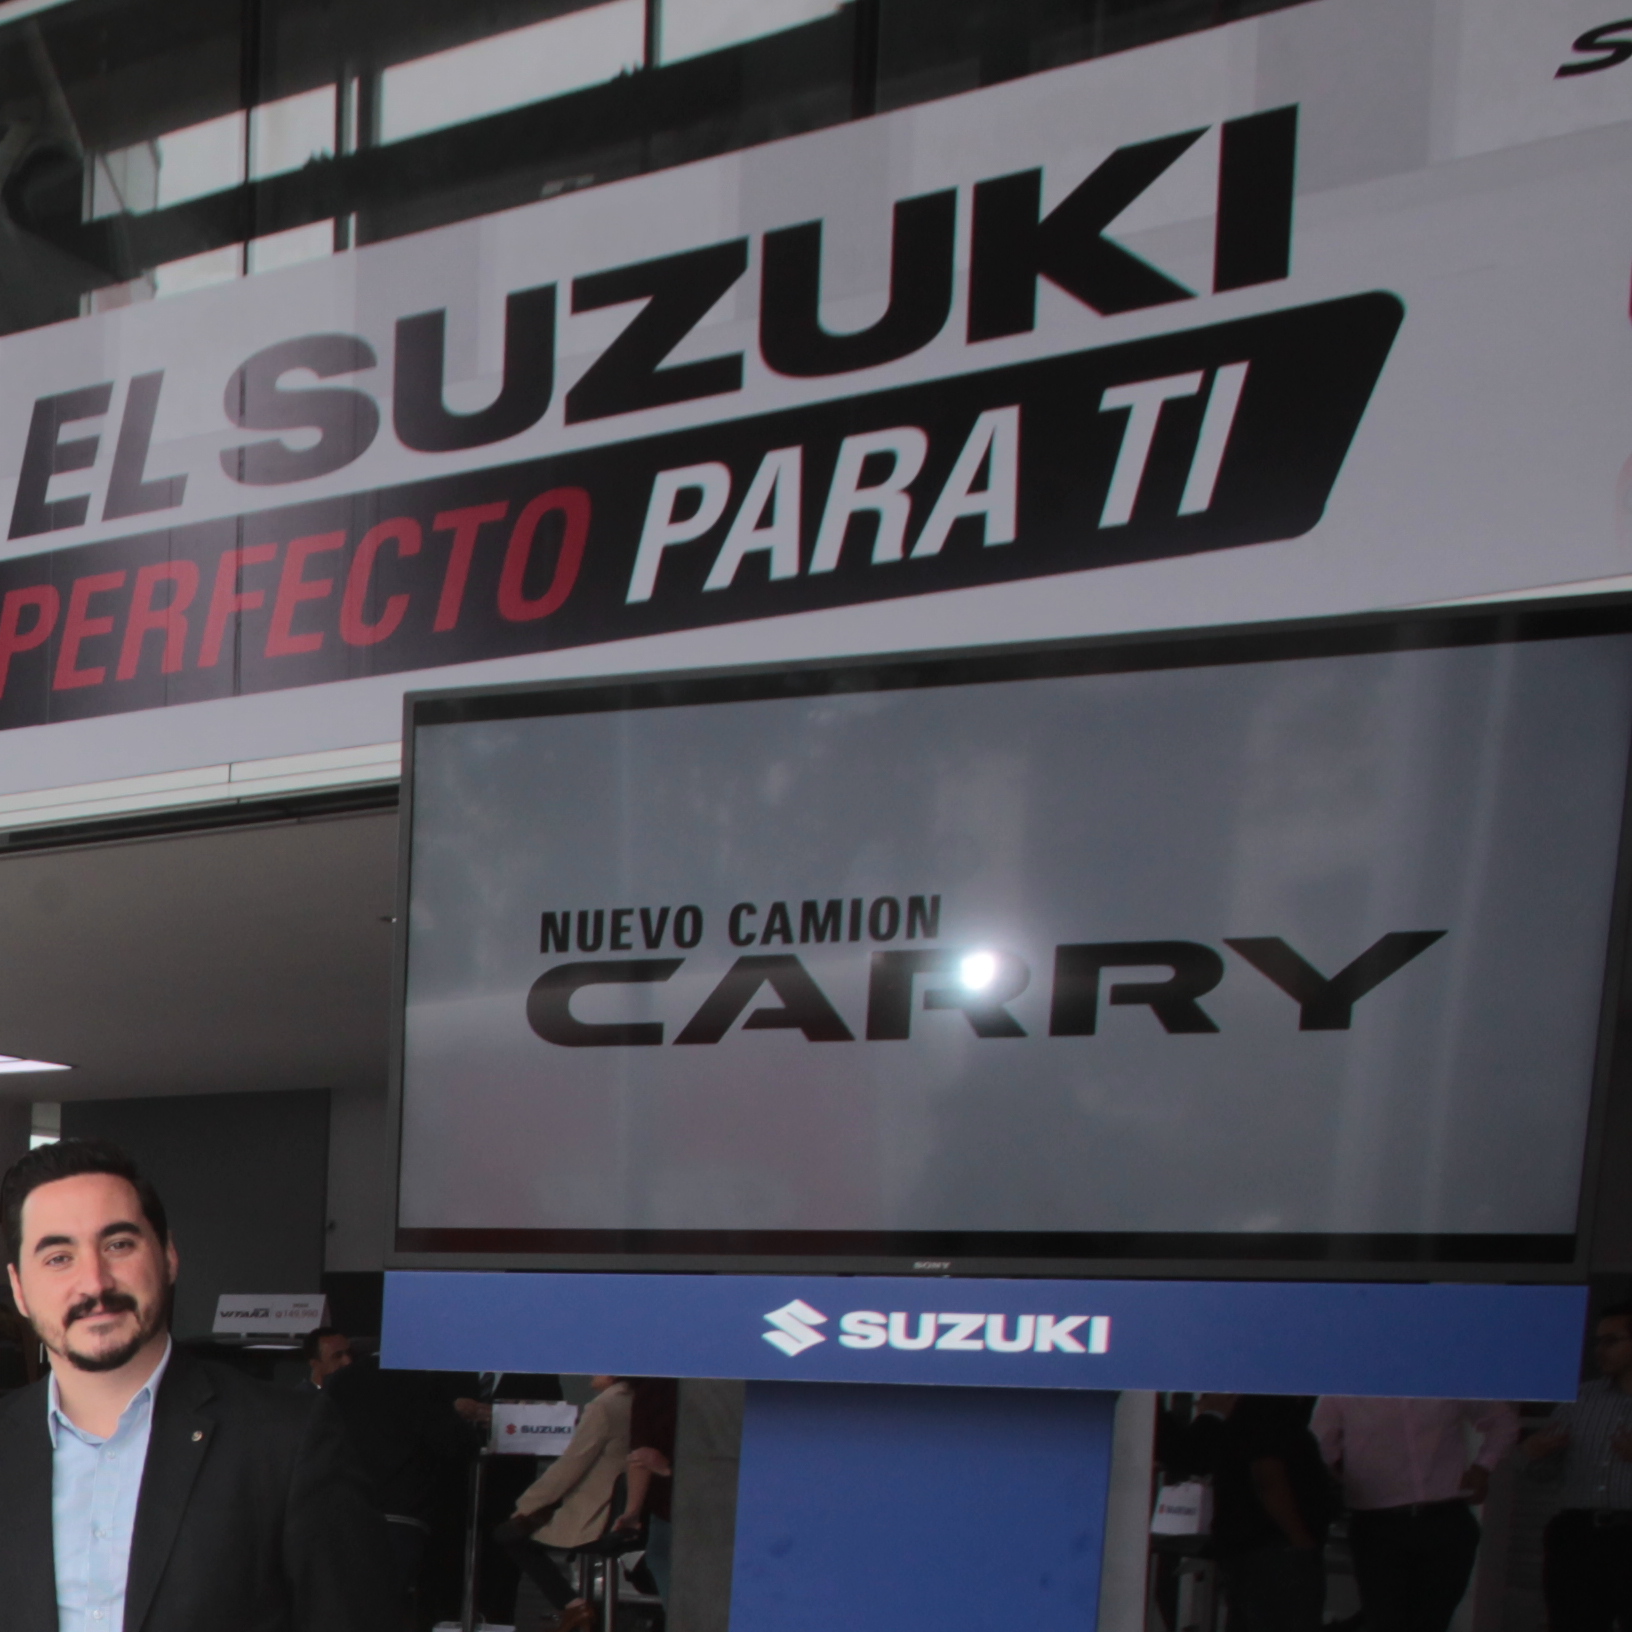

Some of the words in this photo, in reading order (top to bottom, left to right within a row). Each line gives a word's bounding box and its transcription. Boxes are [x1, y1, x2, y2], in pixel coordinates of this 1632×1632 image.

[7, 368, 187, 542] EL
[218, 102, 1299, 486] SUZUKI
[624, 403, 1018, 606] PARA
[1094, 359, 1250, 530] TI
[539, 904, 703, 954] NUEVO
[727, 893, 942, 948] CAMION
[525, 930, 1449, 1048] CARRY
[838, 1310, 1111, 1355] SUZUKI
[521, 1425, 572, 1434] SUZUKI
